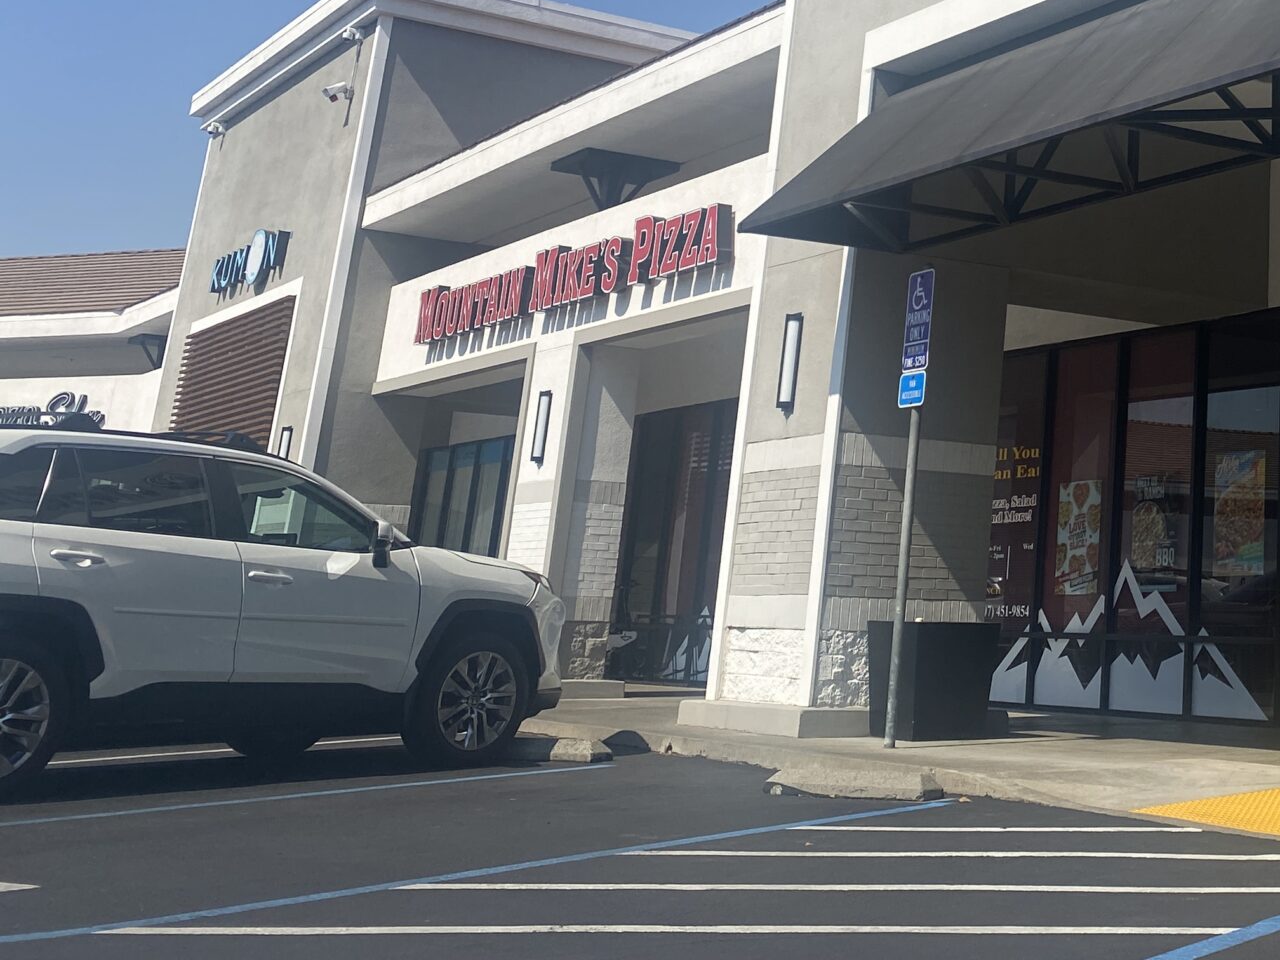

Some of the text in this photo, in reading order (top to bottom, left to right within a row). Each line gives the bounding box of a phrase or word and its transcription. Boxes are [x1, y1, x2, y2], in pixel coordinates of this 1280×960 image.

[208, 228, 282, 293] KUMON
[414, 203, 719, 345] MOUNTAIN MIKE'S PIZZA
[907, 309, 930, 326] PARKING
[909, 325, 925, 341] ONLY
[997, 446, 1040, 460] ll You
[993, 468, 1011, 480] an
[991, 493, 1037, 510] zza, Salad
[991, 509, 1033, 524] nd More!
[1069, 520, 1087, 534] LOVE
[1155, 547, 1175, 567] BBQ
[996, 604, 1030, 618] 451-9854
